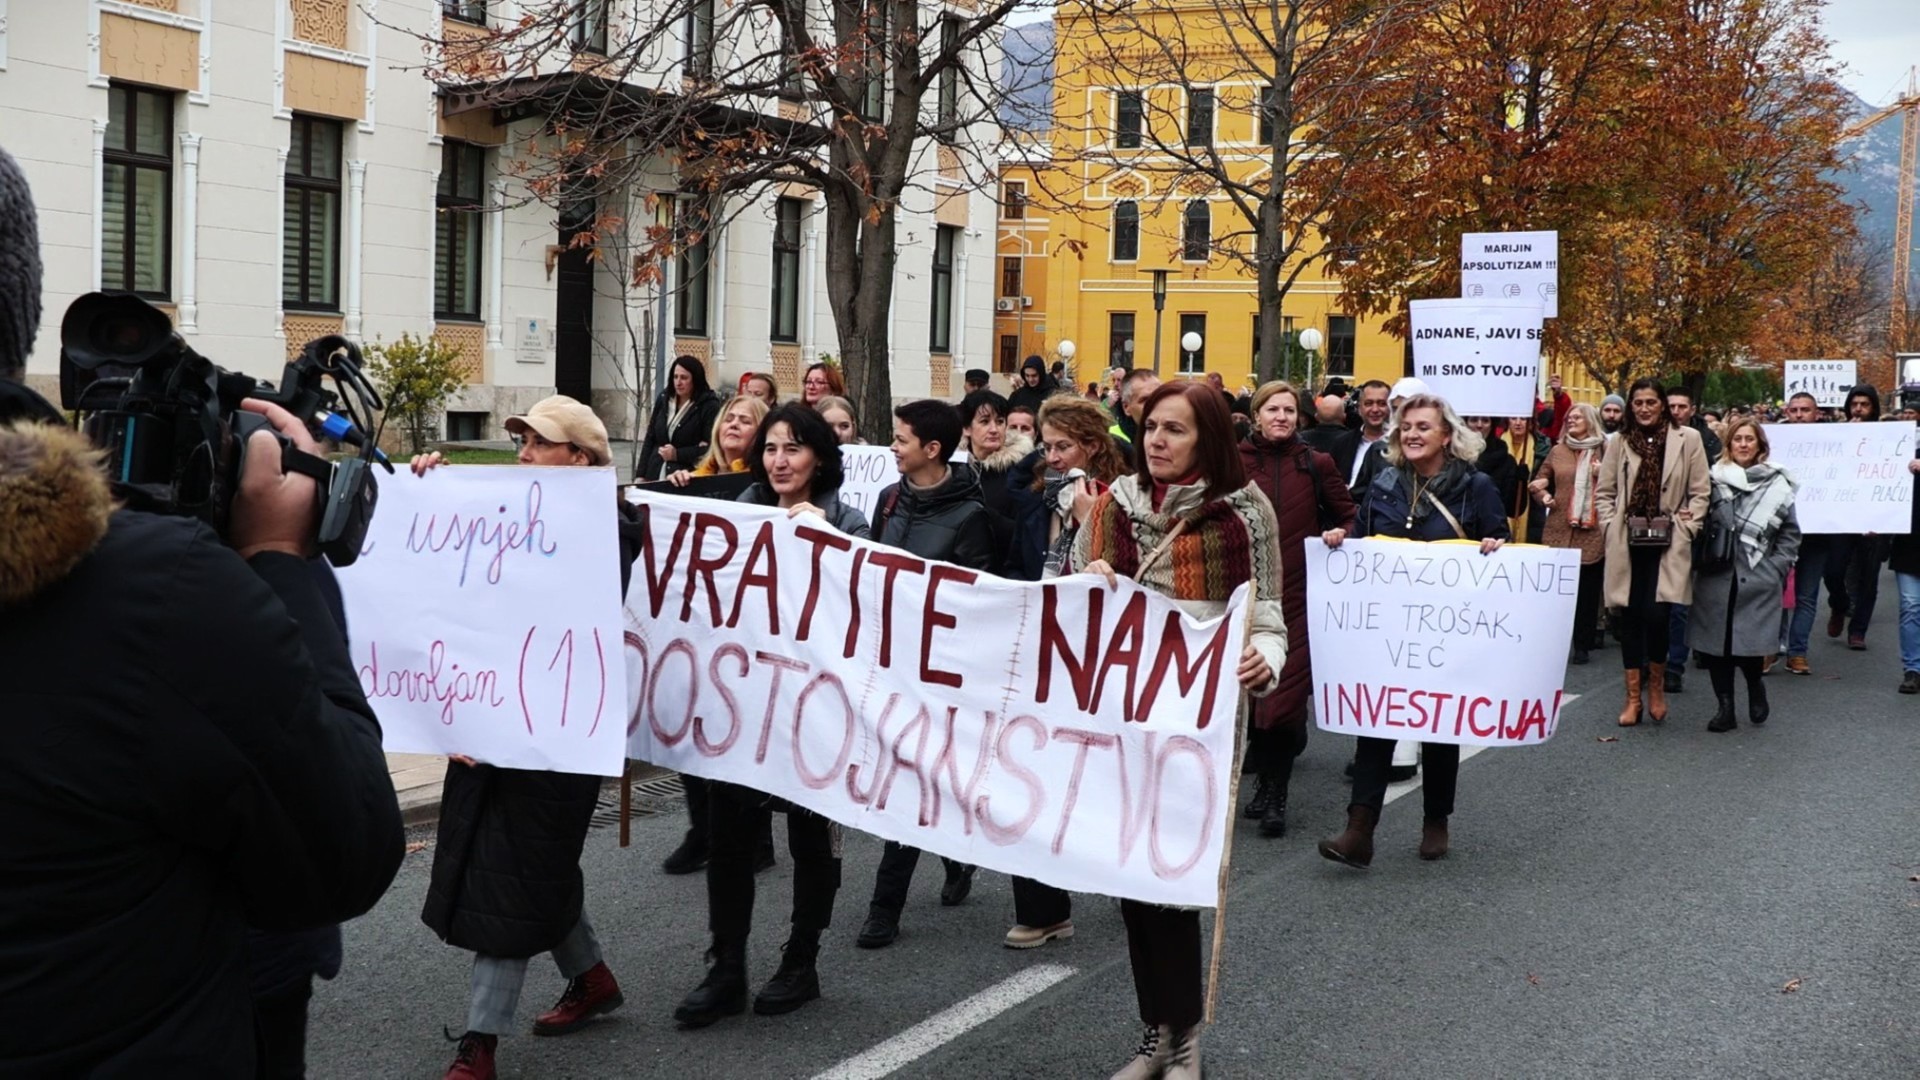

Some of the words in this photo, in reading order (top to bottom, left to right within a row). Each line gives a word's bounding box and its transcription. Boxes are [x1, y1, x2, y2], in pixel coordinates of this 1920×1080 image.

[1484, 244, 1532, 253] MARIJIN
[1463, 260, 1542, 271] APSOLUTIZAM
[1415, 327, 1480, 341] ADNANE,
[1485, 328, 1521, 340] JAVI
[1526, 328, 1544, 340] SE
[1423, 365, 1437, 377] MI
[1442, 364, 1476, 377] SMO
[1481, 364, 1528, 377] TVOJI
[1792, 363, 1844, 371] MORAMO
[1786, 442, 1844, 458] RAZLIKA
[406, 480, 557, 587] uspjeh
[1326, 549, 1578, 596] OBRAZOVANJE
[637, 503, 979, 689] VRATITE
[1035, 584, 1233, 729] NAM
[1324, 601, 1381, 632] NIJE
[1402, 600, 1522, 643] TROŠAK,
[1385, 638, 1445, 669] VEĆ
[518, 624, 605, 737] (1)
[1323, 682, 1562, 741] INVESTICIJA!
